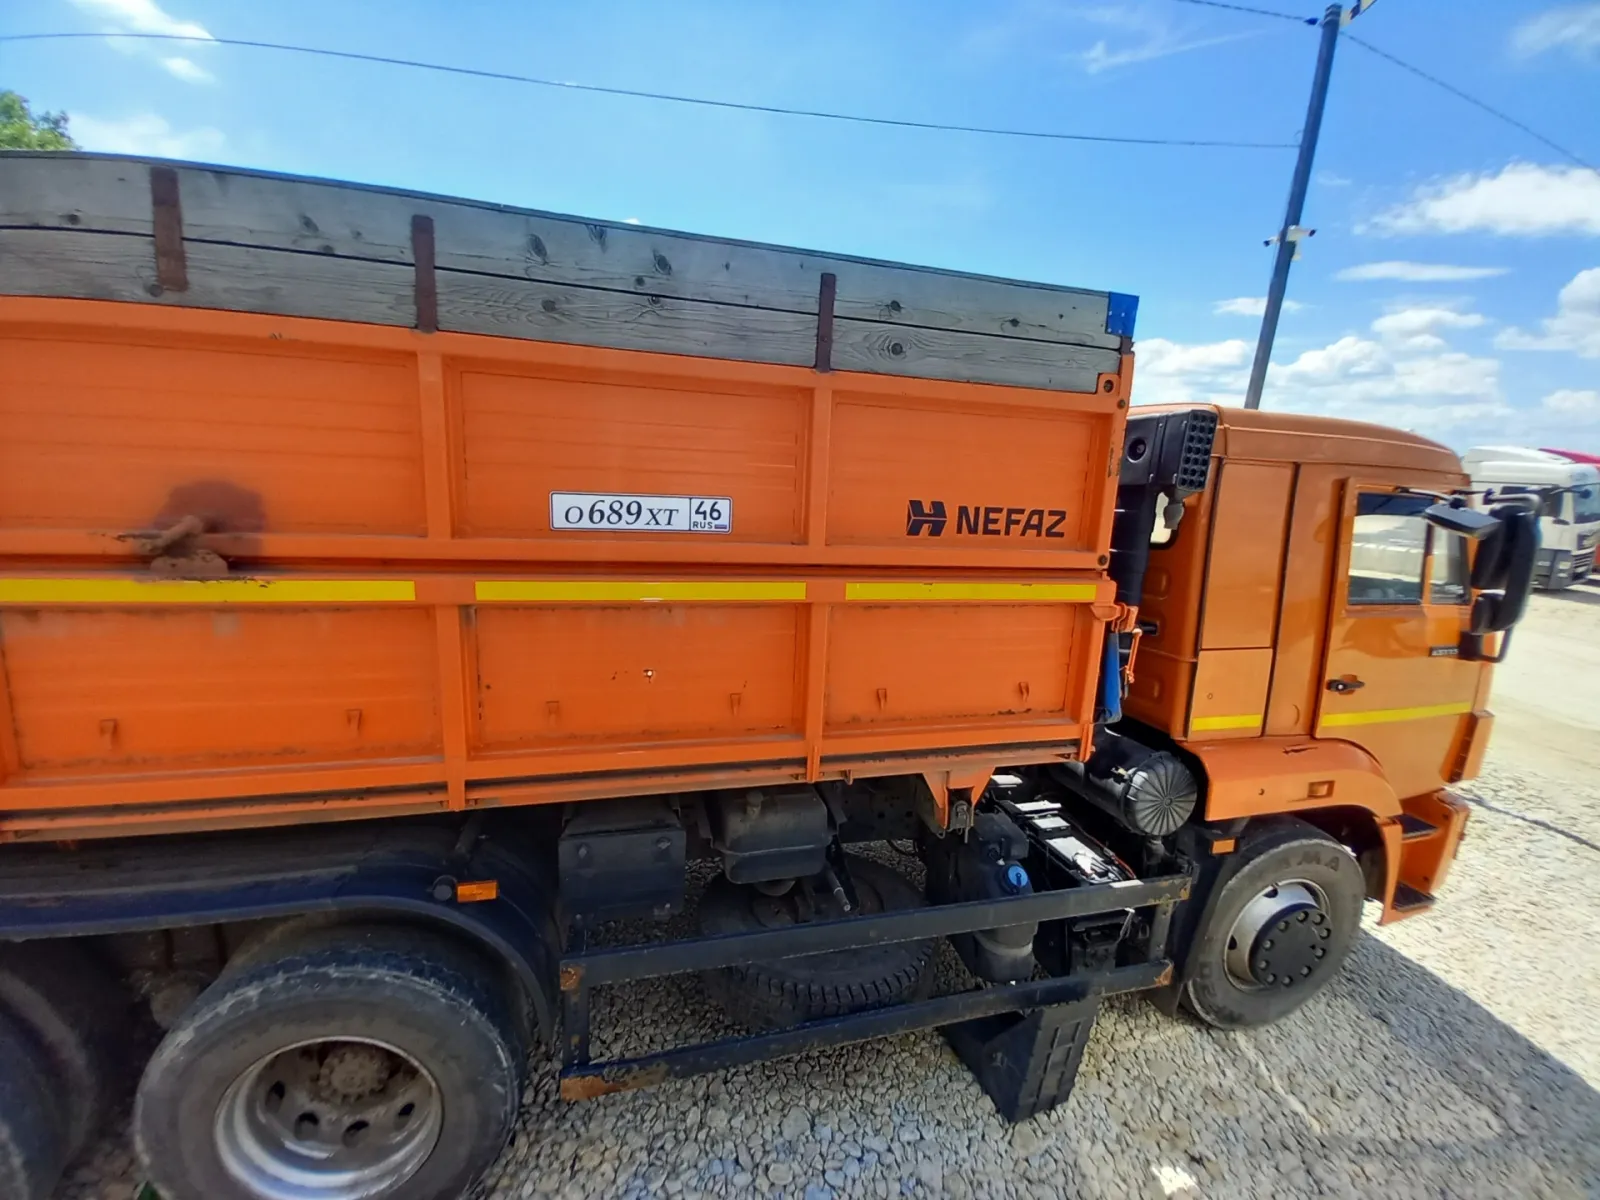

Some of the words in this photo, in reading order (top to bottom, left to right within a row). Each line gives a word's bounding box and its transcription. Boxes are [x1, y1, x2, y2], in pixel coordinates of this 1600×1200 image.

[694, 500, 722, 521] 46
[692, 521, 713, 530] RUS
[956, 505, 1067, 538] NEFAZ
